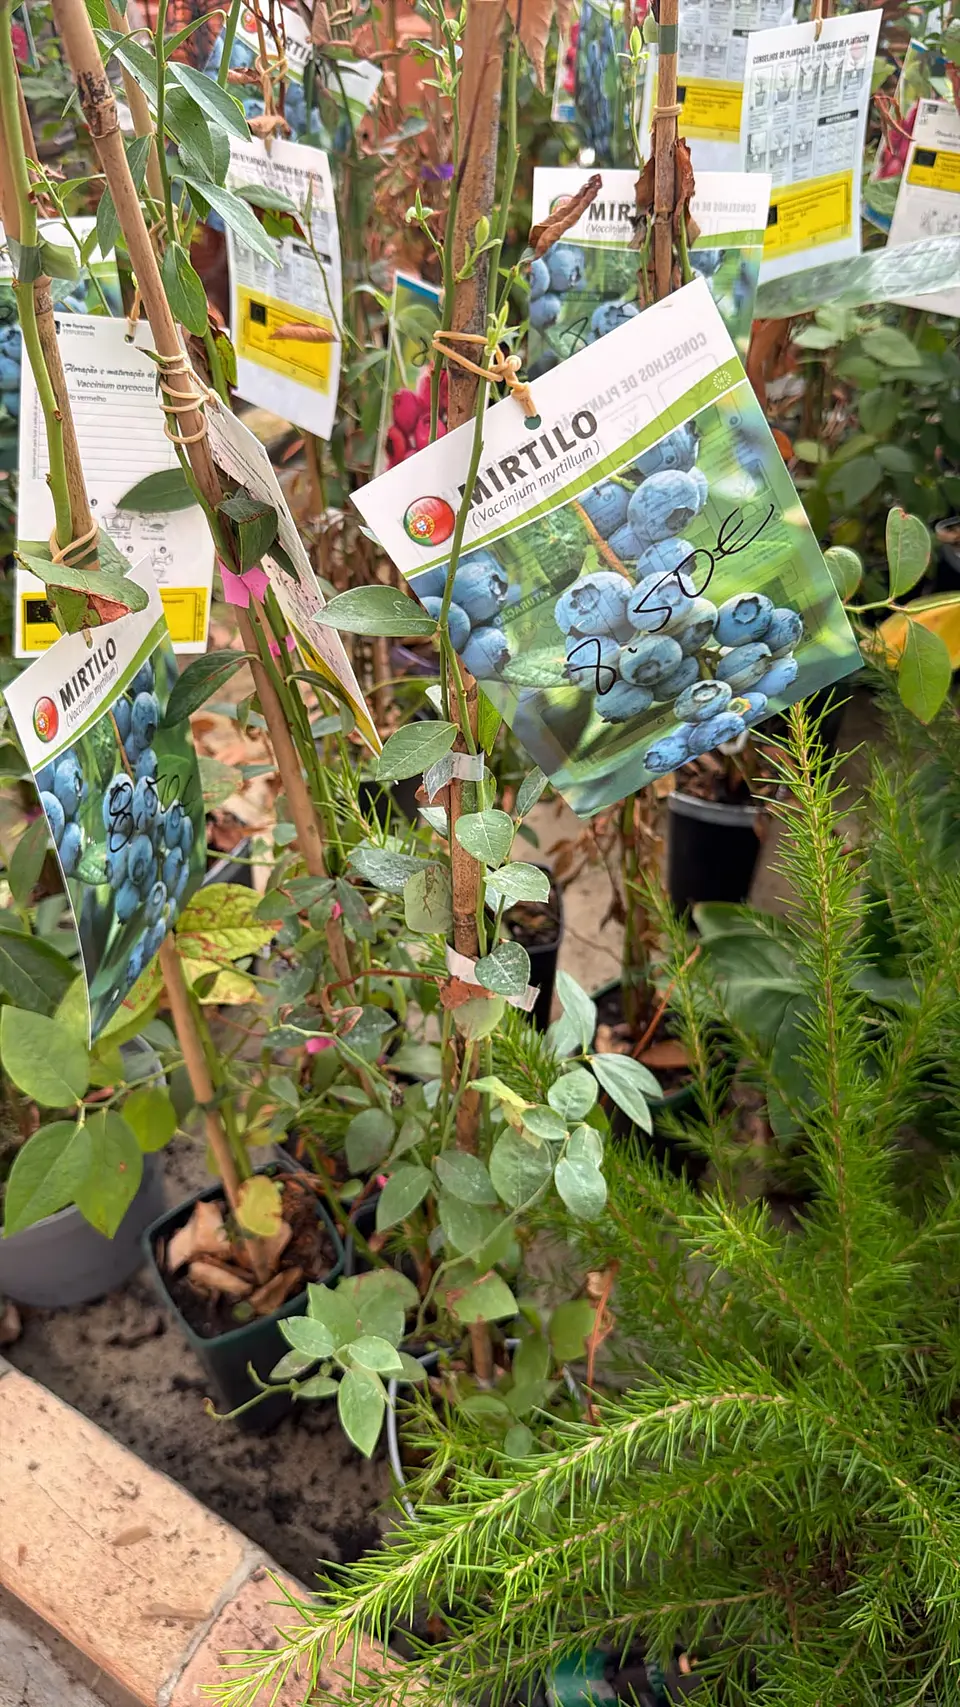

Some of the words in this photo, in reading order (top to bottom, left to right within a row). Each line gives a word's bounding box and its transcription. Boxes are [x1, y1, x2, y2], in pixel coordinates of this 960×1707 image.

[64, 363, 98, 376] Floração
[76, 380, 115, 390] Vaccinium
[116, 383, 154, 393] oxycoccus
[457, 410, 598, 510] MIRTILO
[59, 637, 117, 711] MIRTILO
